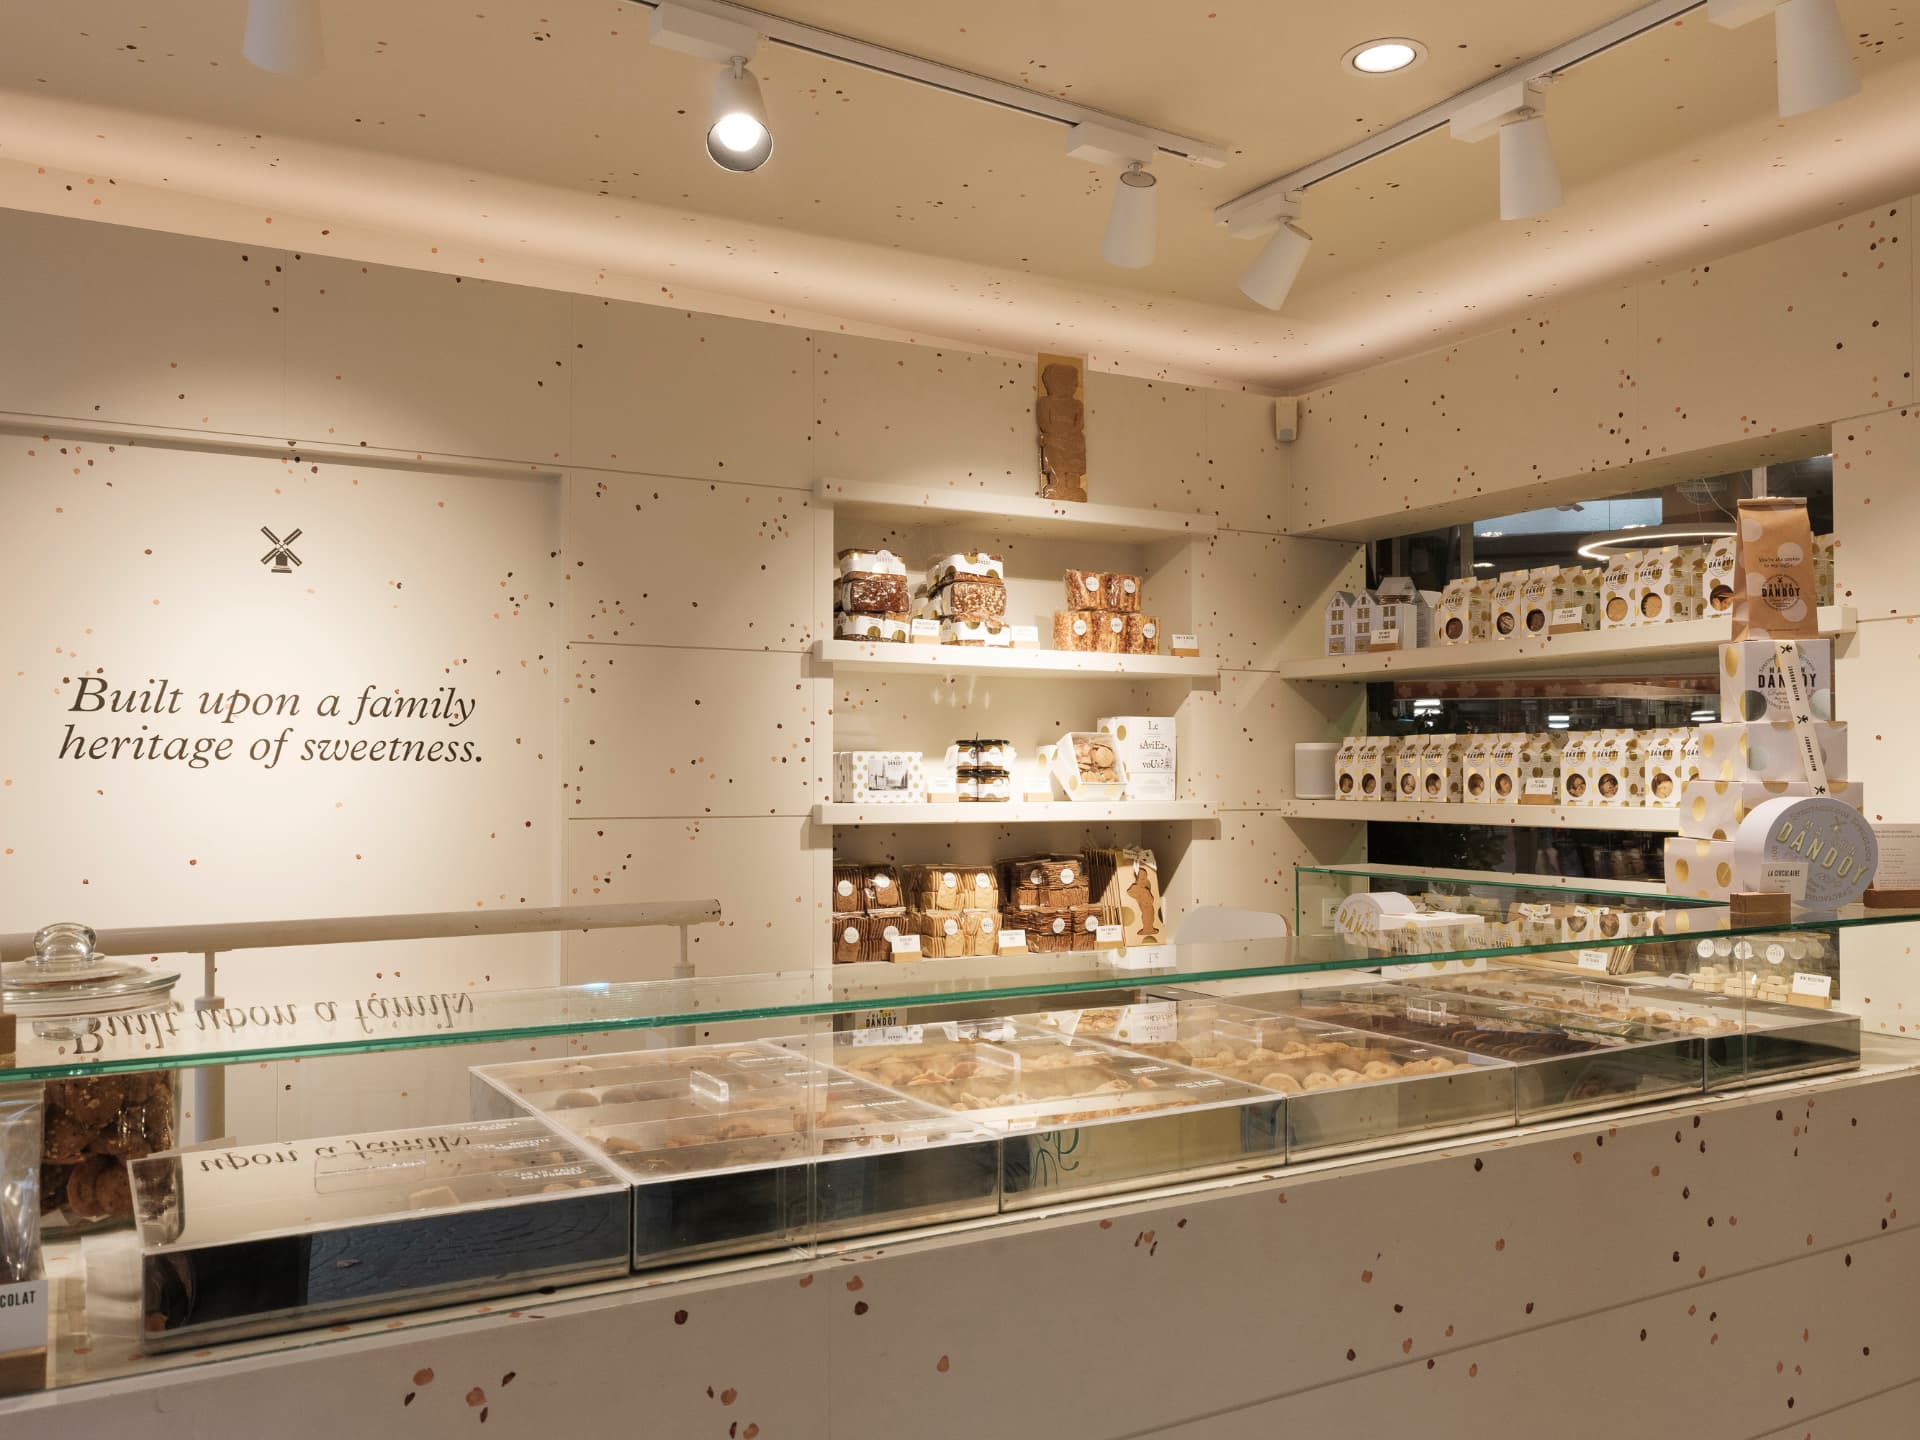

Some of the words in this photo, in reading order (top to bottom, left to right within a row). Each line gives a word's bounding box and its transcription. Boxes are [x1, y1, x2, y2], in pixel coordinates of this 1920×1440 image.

[1761, 587, 1801, 598] DANDOY
[68, 677, 184, 715] Built
[199, 689, 301, 724] upon
[317, 693, 341, 718] a
[348, 685, 476, 728] family
[58, 723, 234, 769] heritage
[249, 727, 295, 770] of
[300, 736, 483, 764] sweetness.
[1776, 821, 1869, 886] DANDOY
[865, 1016, 897, 1028] DANDOY
[0, 1290, 36, 1308] COLAT
